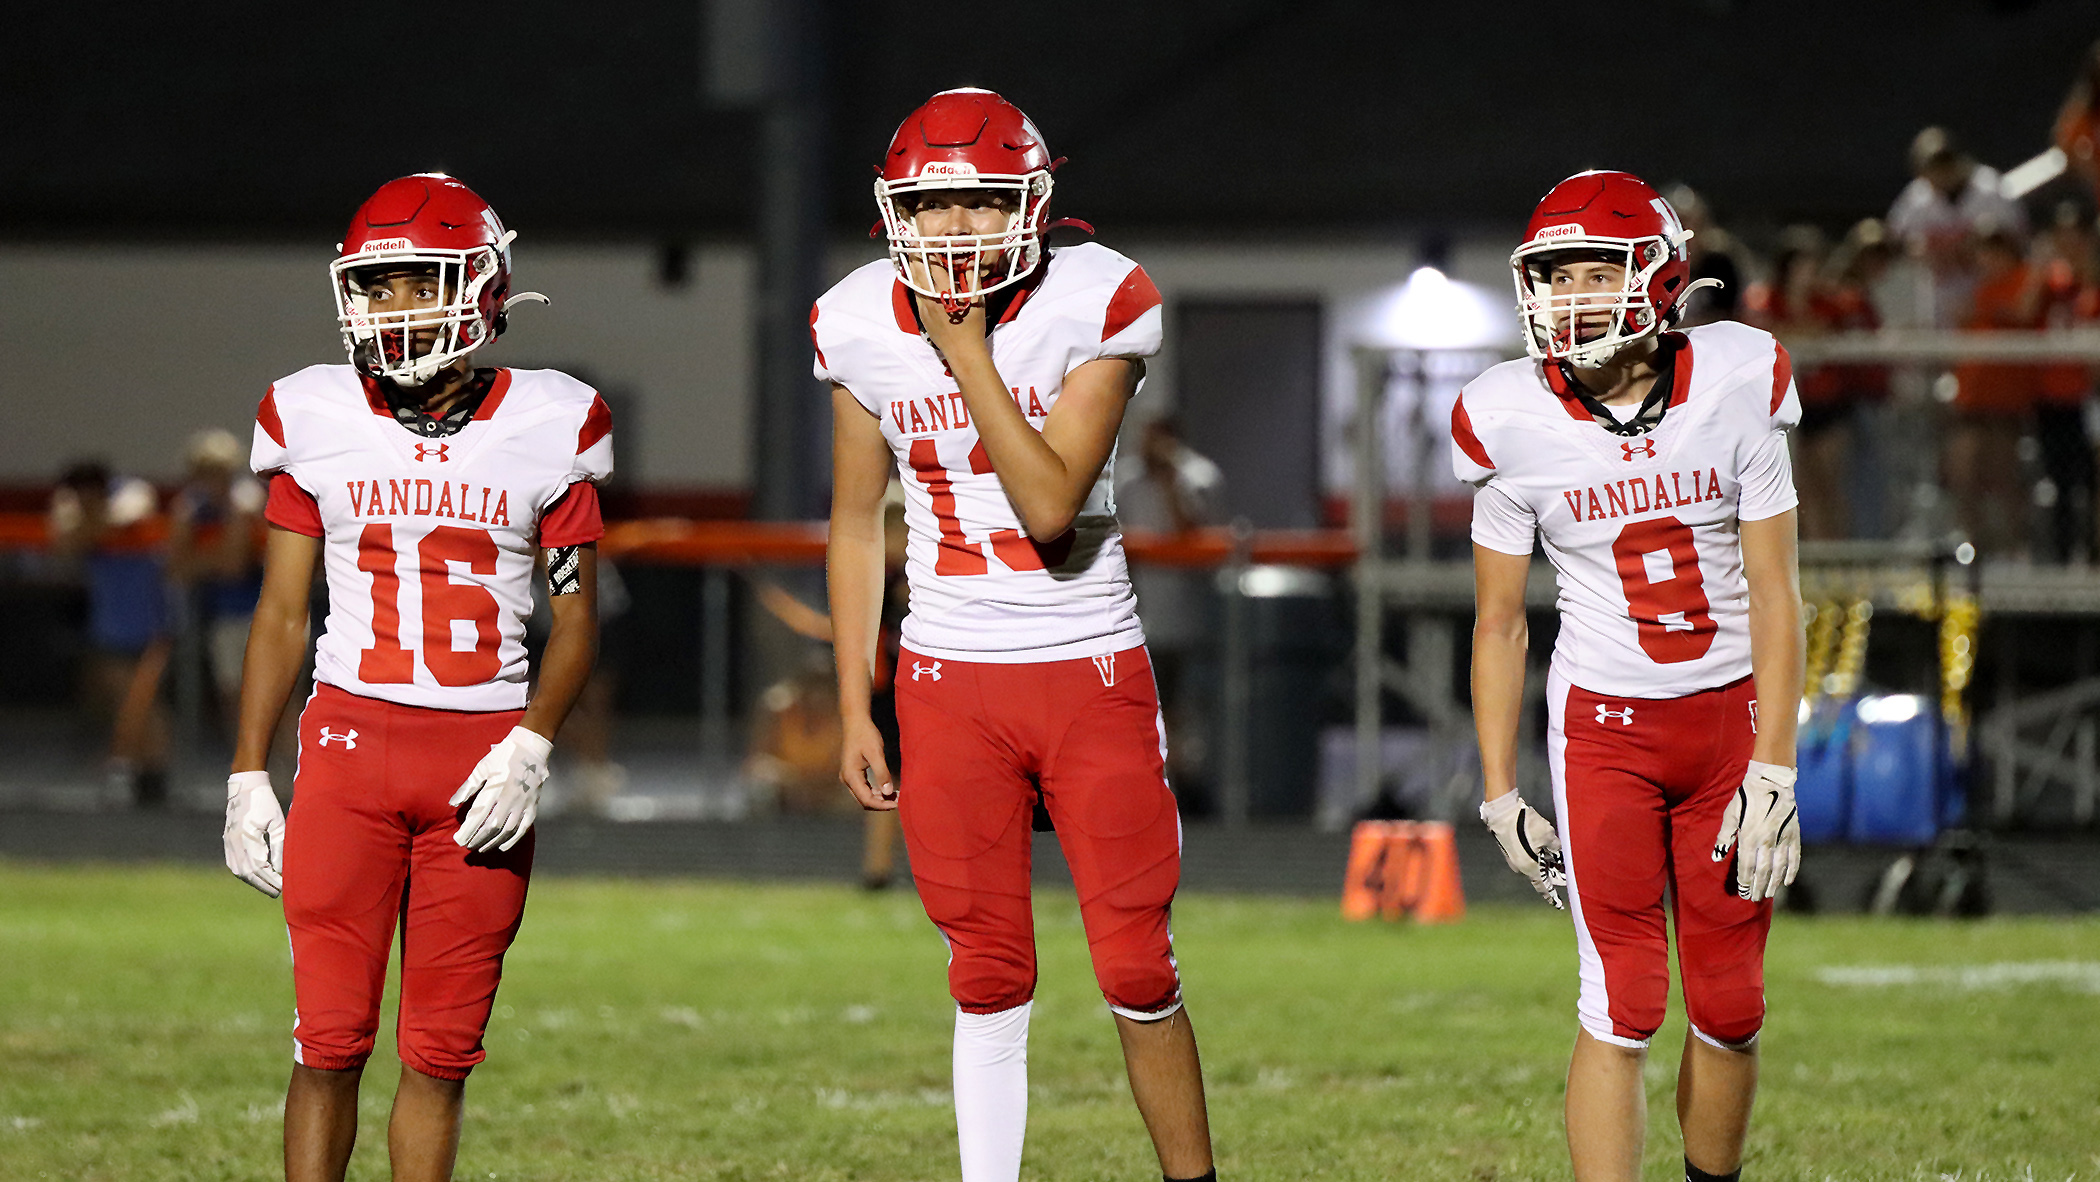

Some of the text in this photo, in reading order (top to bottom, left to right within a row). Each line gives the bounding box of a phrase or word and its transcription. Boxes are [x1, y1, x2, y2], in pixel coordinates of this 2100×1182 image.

[364, 240, 406, 252] Riddell
[1538, 225, 1577, 240] Riddell
[891, 386, 1048, 434] VANDIA
[347, 478, 510, 526] VANDALIA
[1563, 467, 1724, 522] VANDALIA
[357, 523, 503, 687] 16
[1611, 515, 1719, 664] 8
